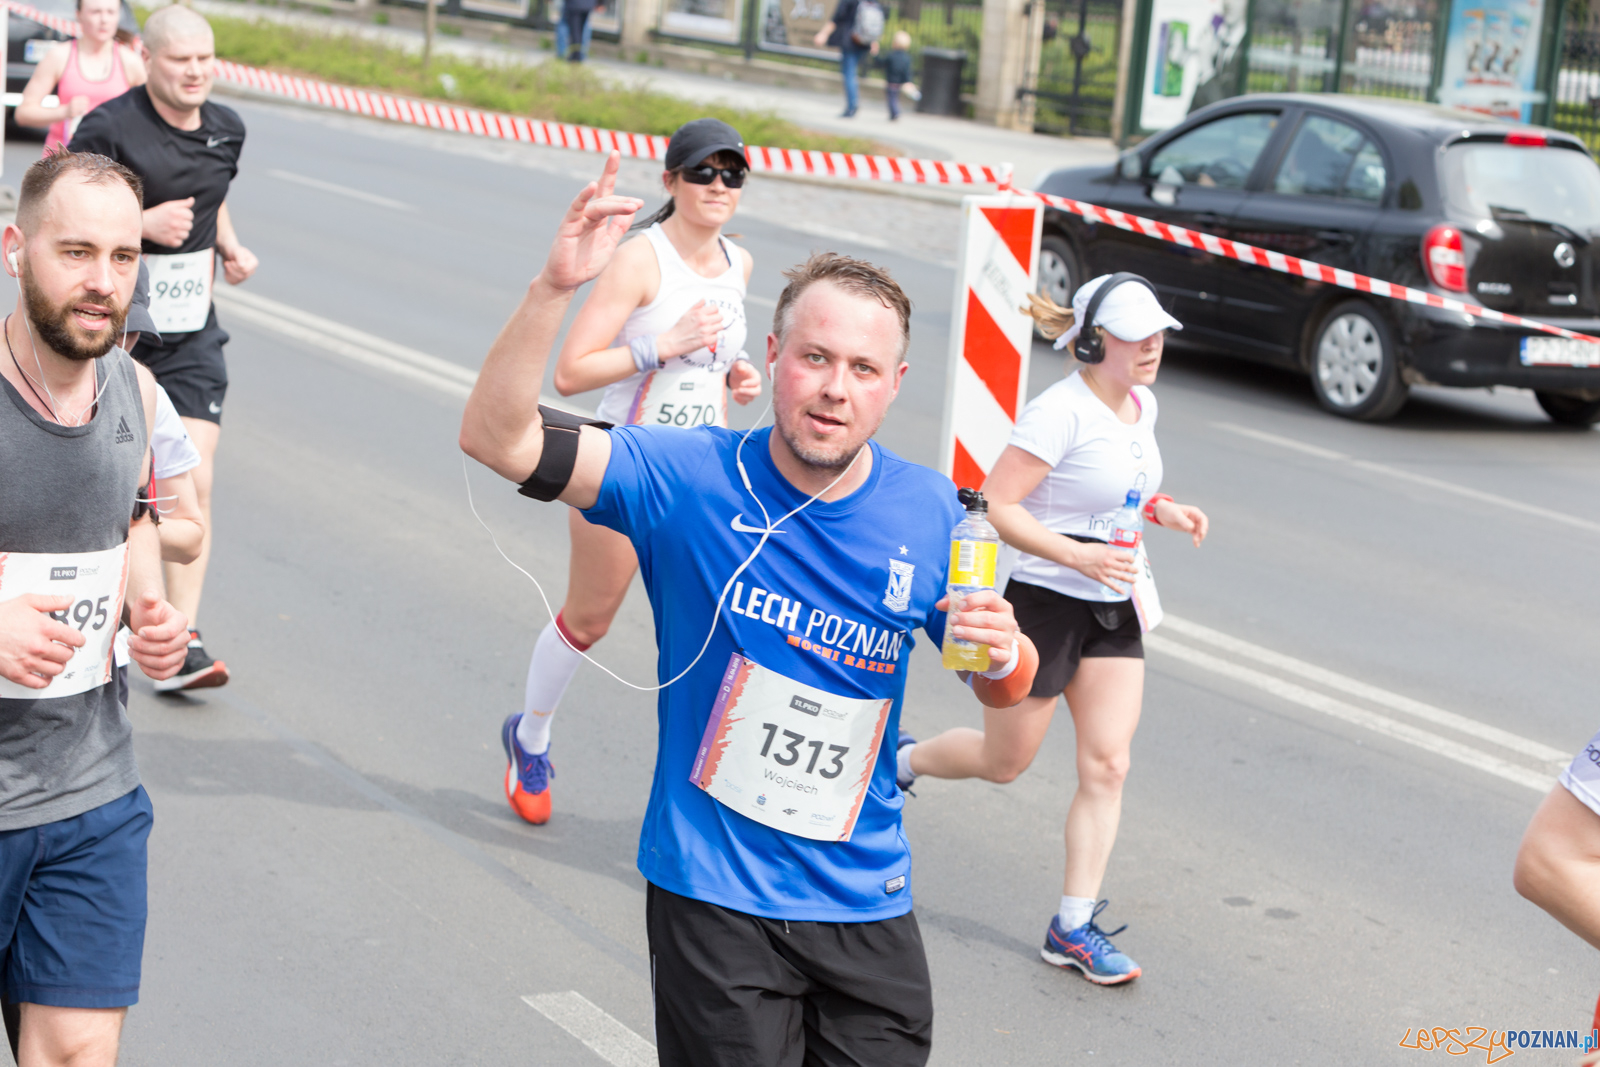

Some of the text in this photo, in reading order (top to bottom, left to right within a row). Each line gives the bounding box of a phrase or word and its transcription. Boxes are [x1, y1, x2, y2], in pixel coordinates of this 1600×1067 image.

[156, 278, 204, 299] 9696
[657, 403, 716, 427] 5670
[730, 581, 906, 661] LECH POZNAŃ
[786, 634, 896, 674] MOCNI RAZEM
[723, 685, 731, 693] D
[760, 722, 850, 779] 1313
[764, 768, 819, 796] Wojciech
